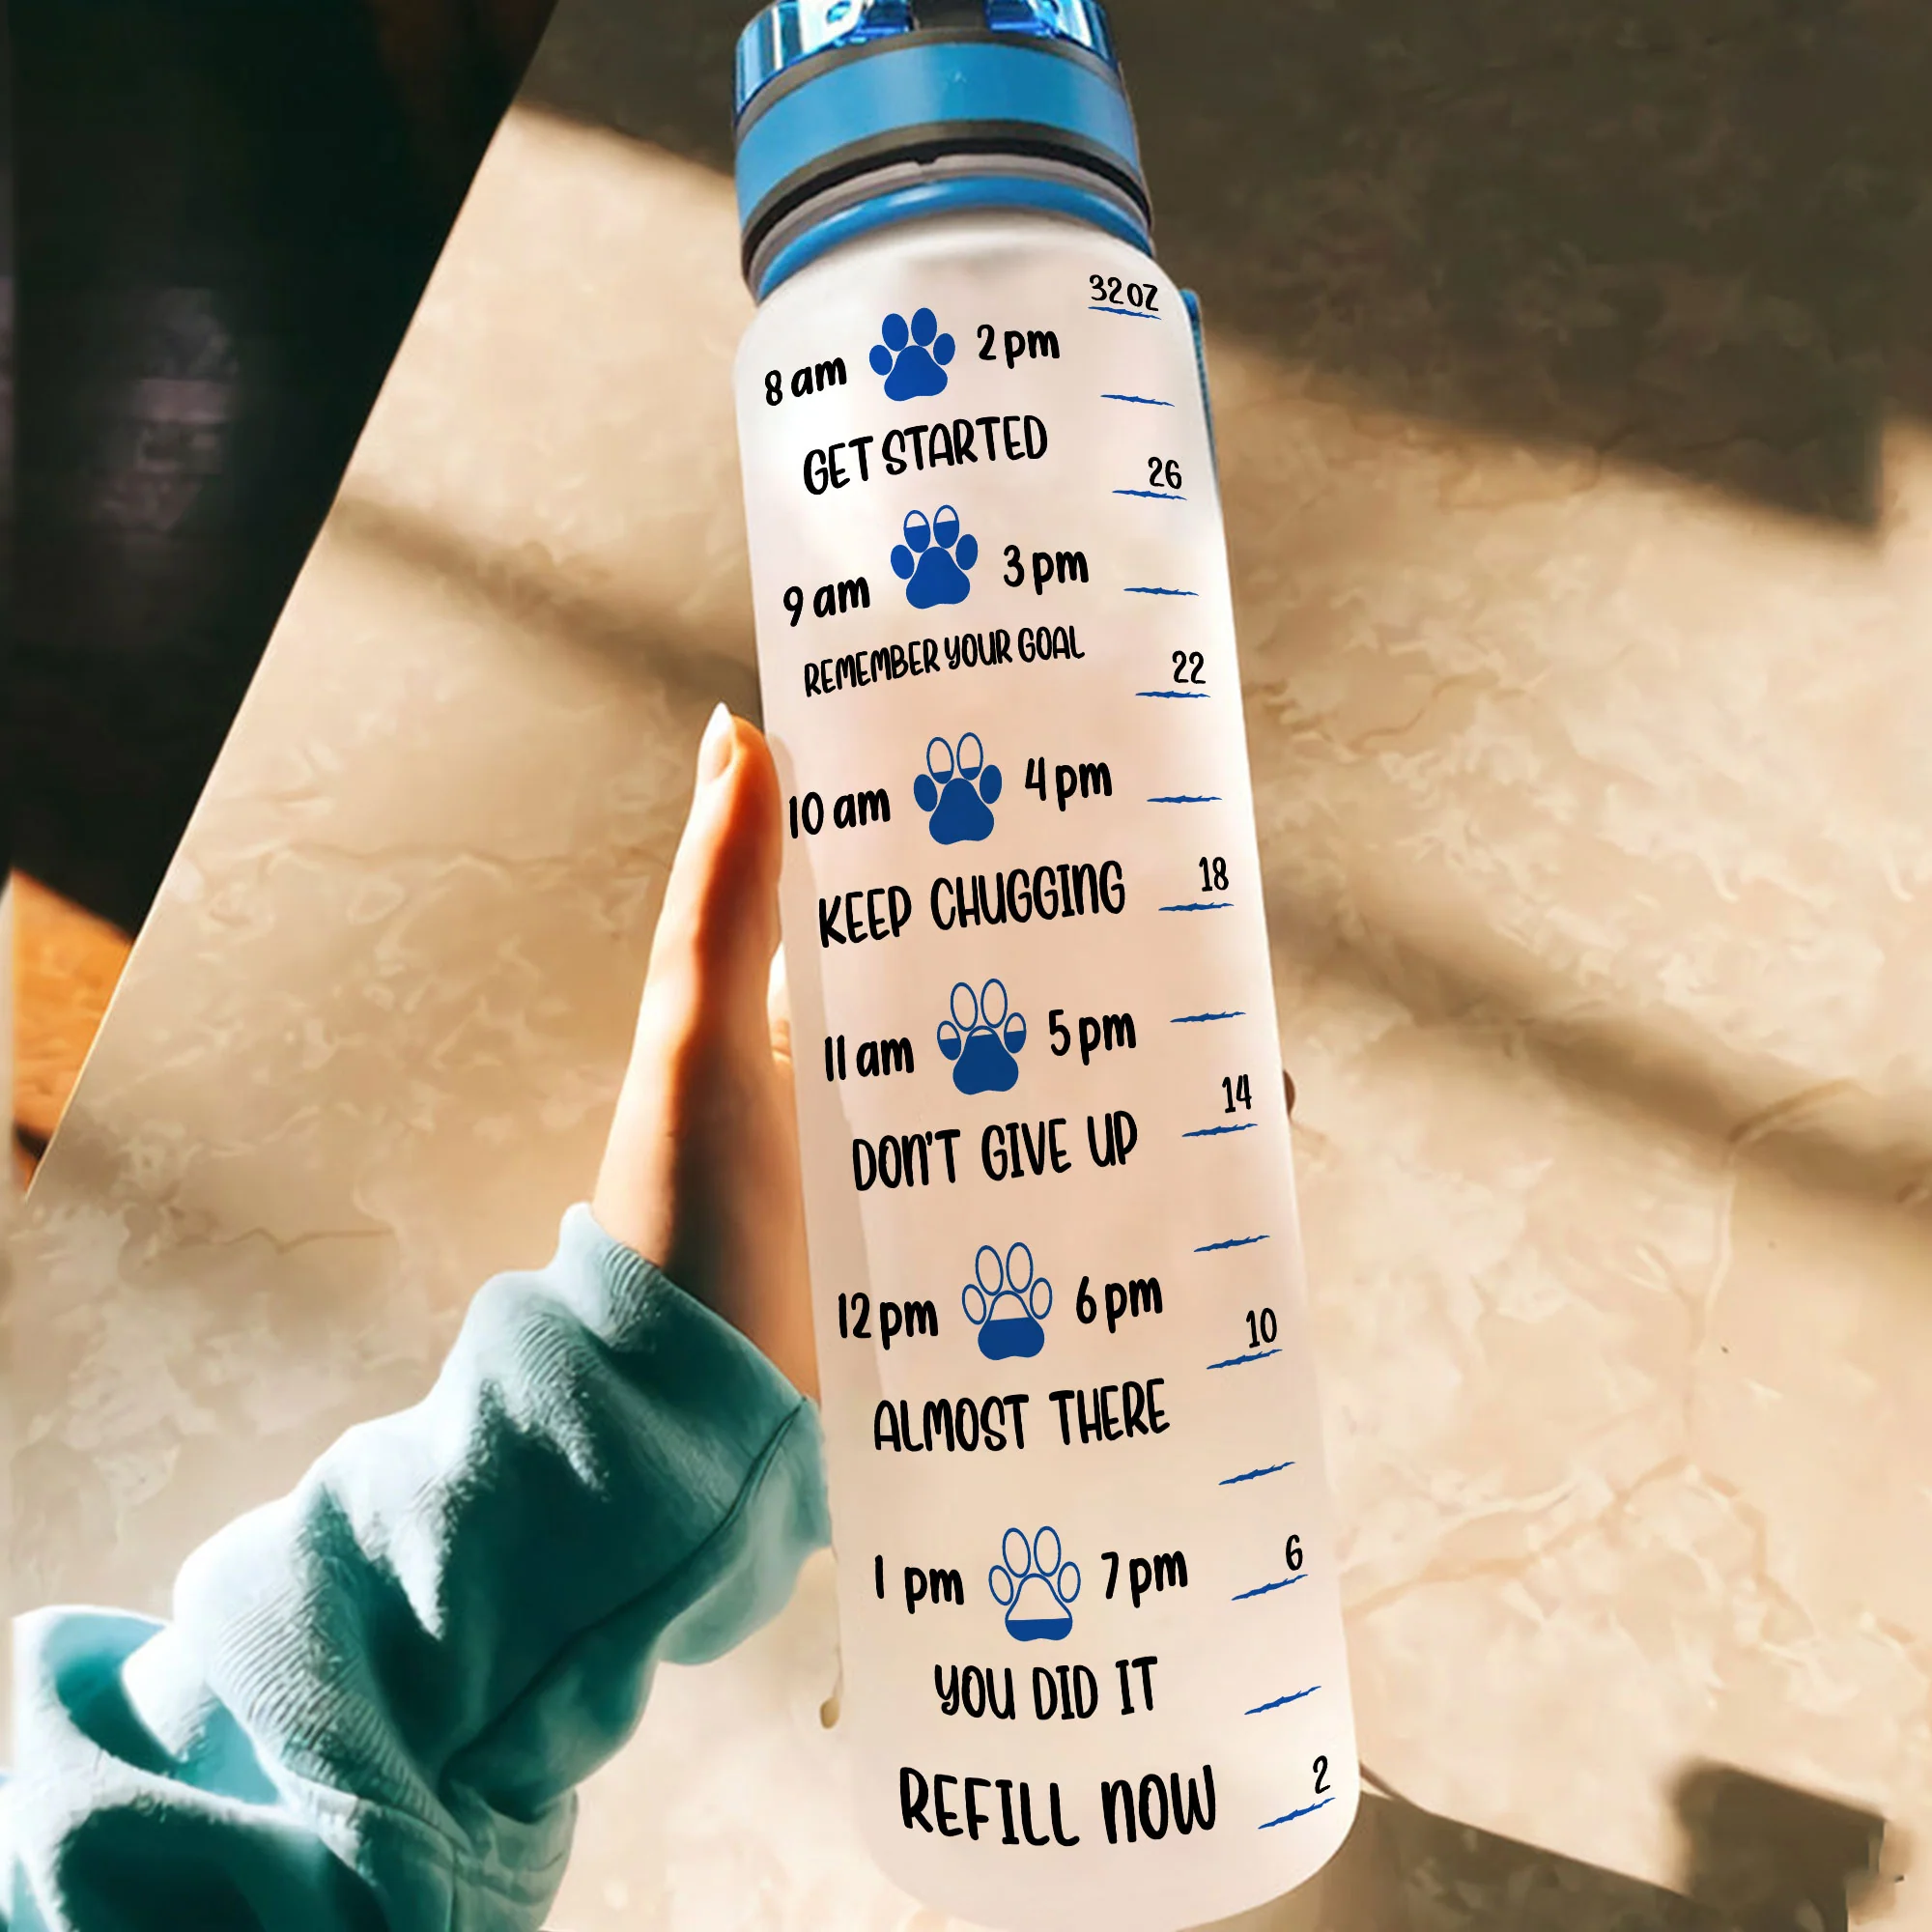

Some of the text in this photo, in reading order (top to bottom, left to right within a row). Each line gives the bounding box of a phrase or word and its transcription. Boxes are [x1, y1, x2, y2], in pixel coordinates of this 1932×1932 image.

[803, 414, 1048, 496] GET STARTED
[1147, 456, 1182, 490] 26
[804, 625, 1086, 698] REMEMBER YOUR GOAL
[1172, 650, 1207, 685] 22
[818, 860, 1126, 949] KEEP CHUGGING
[1198, 856, 1230, 893] 18
[1221, 1073, 1253, 1114] 14
[852, 1110, 1138, 1192] DON'T GIVE UP
[1245, 1307, 1278, 1350] 10
[873, 1378, 1171, 1453] ALMOST THERE
[1285, 1534, 1304, 1572] 6
[874, 1554, 965, 1615] 1 pm
[934, 1655, 1158, 1720] YOU DID IT
[1312, 1754, 1331, 1795] 2
[899, 1764, 1216, 1847] REFILL NOW
